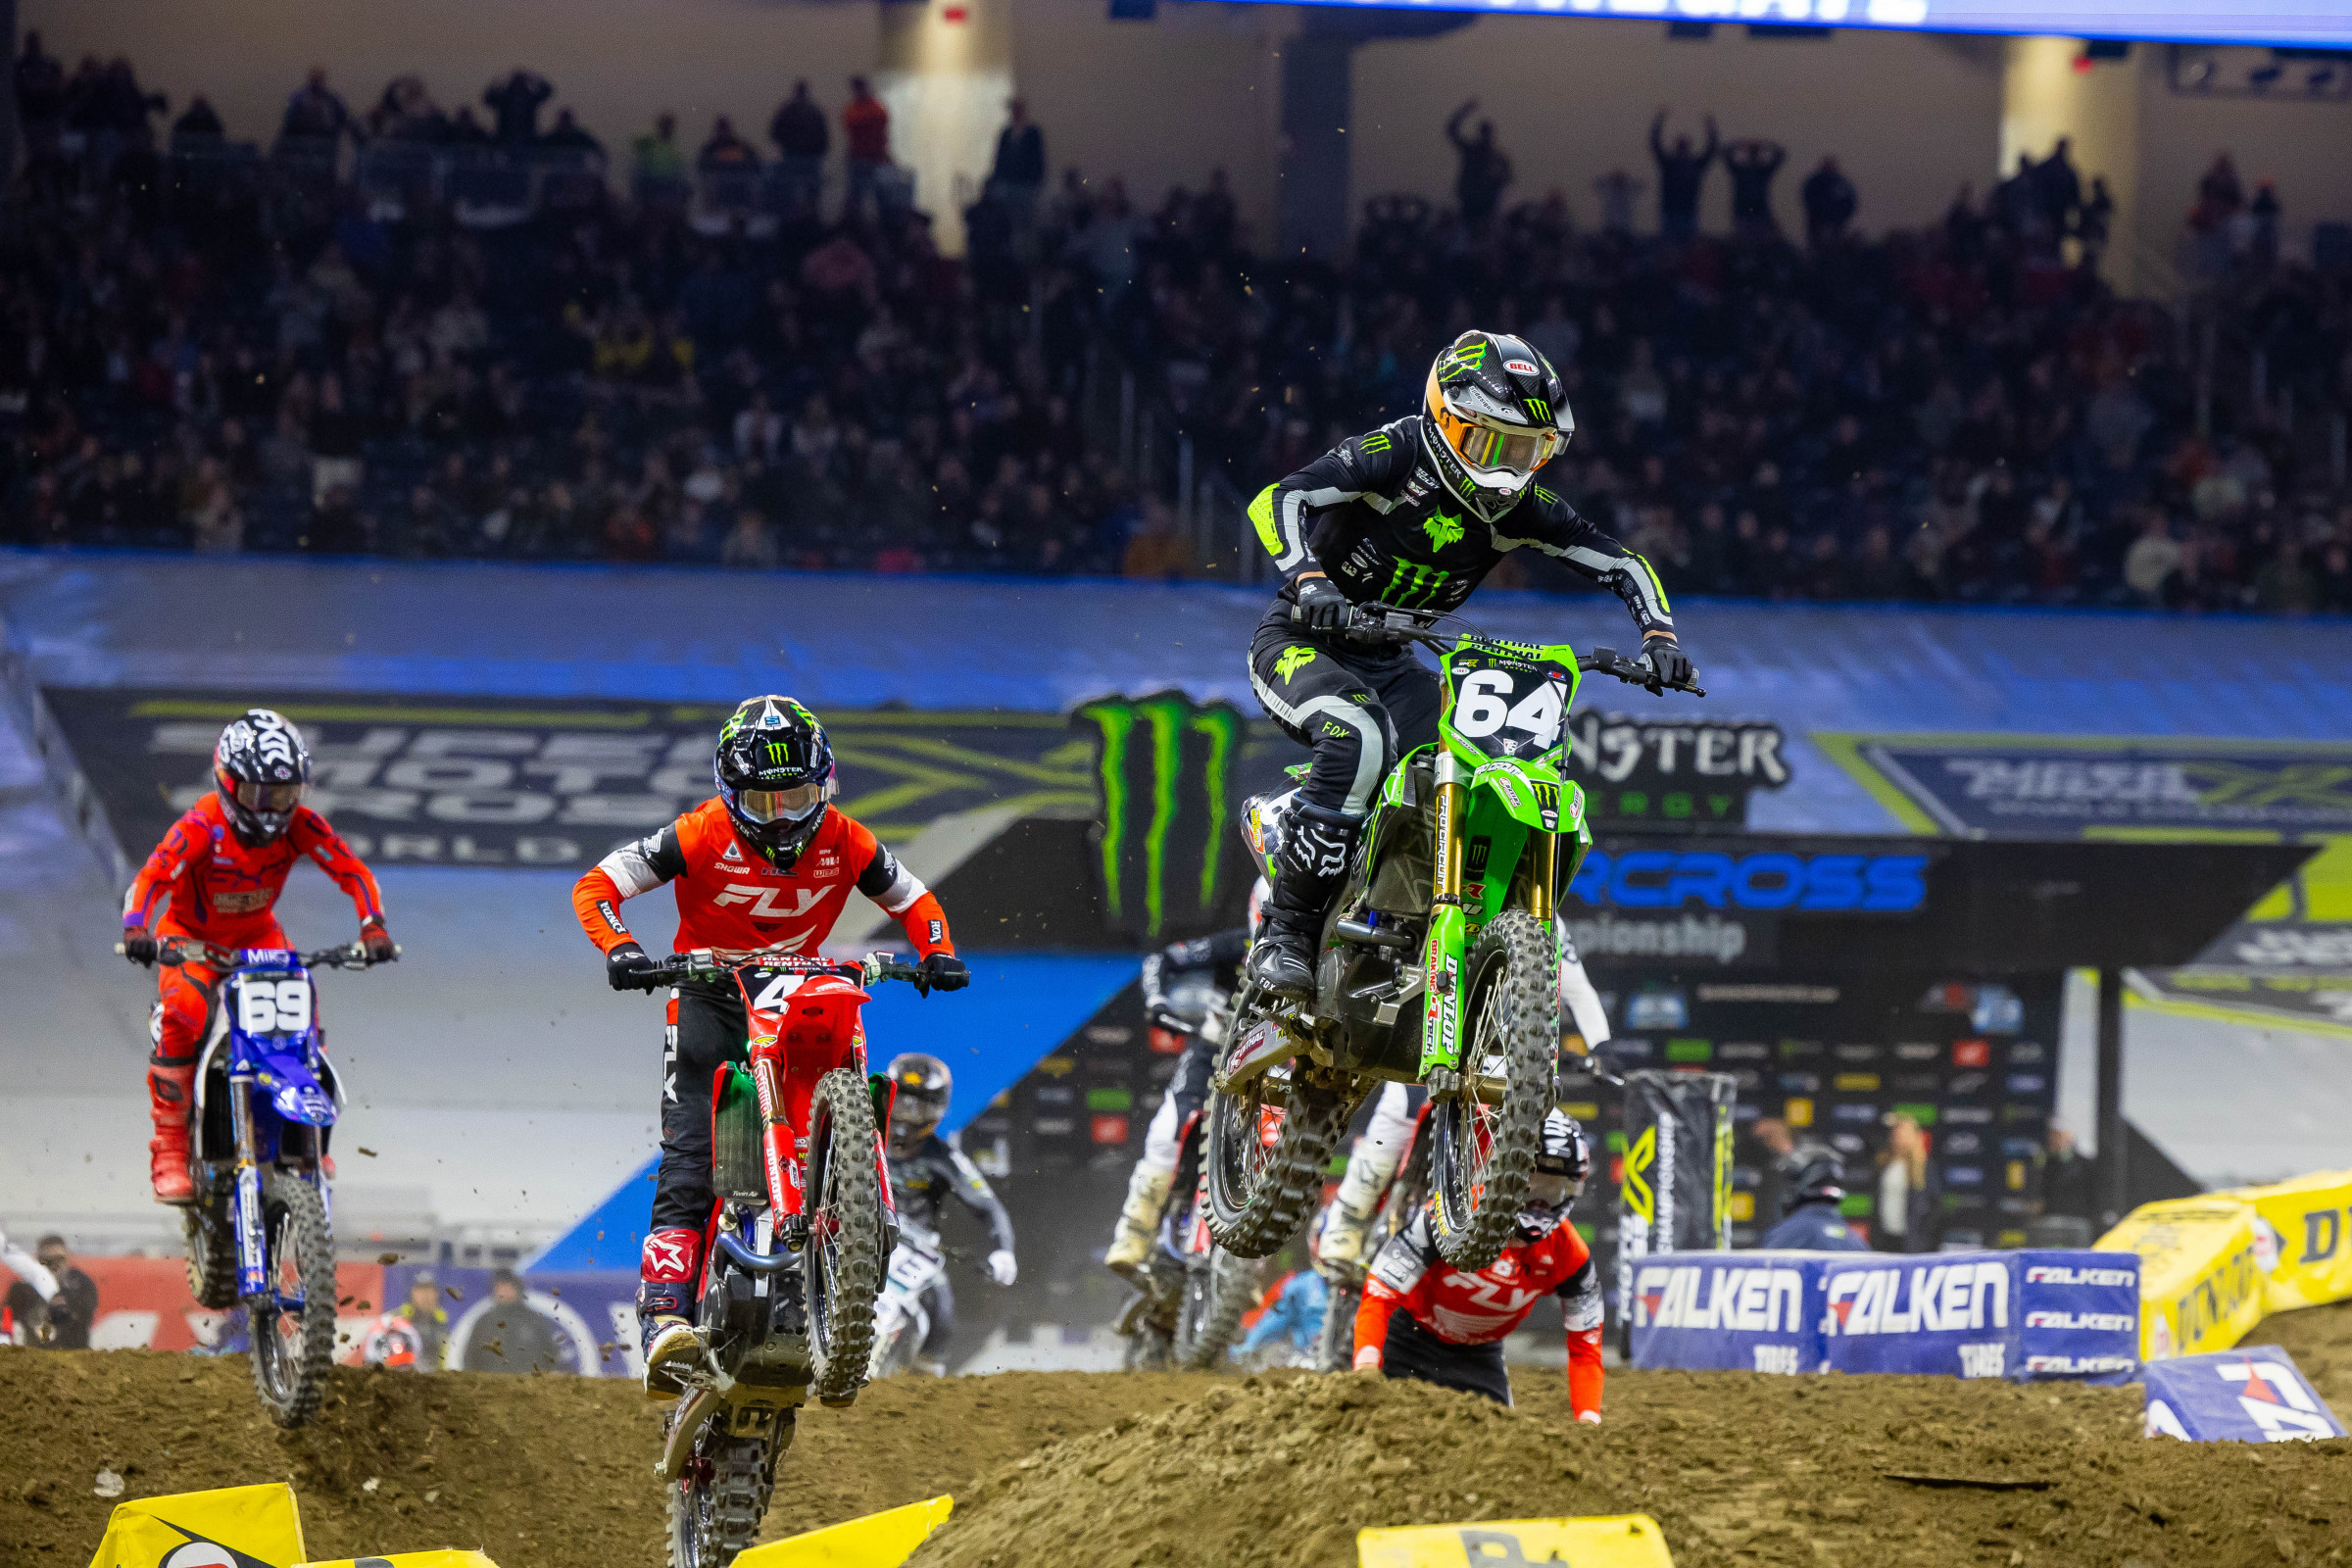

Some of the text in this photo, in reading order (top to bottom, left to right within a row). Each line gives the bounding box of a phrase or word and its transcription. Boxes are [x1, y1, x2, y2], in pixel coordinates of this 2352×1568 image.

[1509, 363, 1535, 372] BELL
[1428, 426, 1462, 478] MONSTER
[1499, 660, 1538, 672] MONSTER
[1322, 721, 1349, 738] FOX
[1454, 669, 1567, 750] 64
[759, 766, 804, 776] MONSTER
[714, 862, 750, 874] SHOWA
[1569, 851, 1927, 911] RCROSS
[713, 883, 837, 917] FLY
[1571, 913, 1745, 964] pionship
[1259, 977, 1276, 991] FOX
[1429, 940, 1438, 992] BRAKING
[238, 980, 311, 1033] 69
[1442, 953, 1458, 1055] DUNLOP
[766, 1147, 781, 1205] DUNLOP
[2026, 1266, 2134, 1287] FALKEN
[1635, 1266, 1803, 1333] FALKEN
[1827, 1261, 2010, 1337] FALKEN
[2026, 1311, 2134, 1332] FALKEN
[2026, 1356, 2134, 1375] FALKEN
